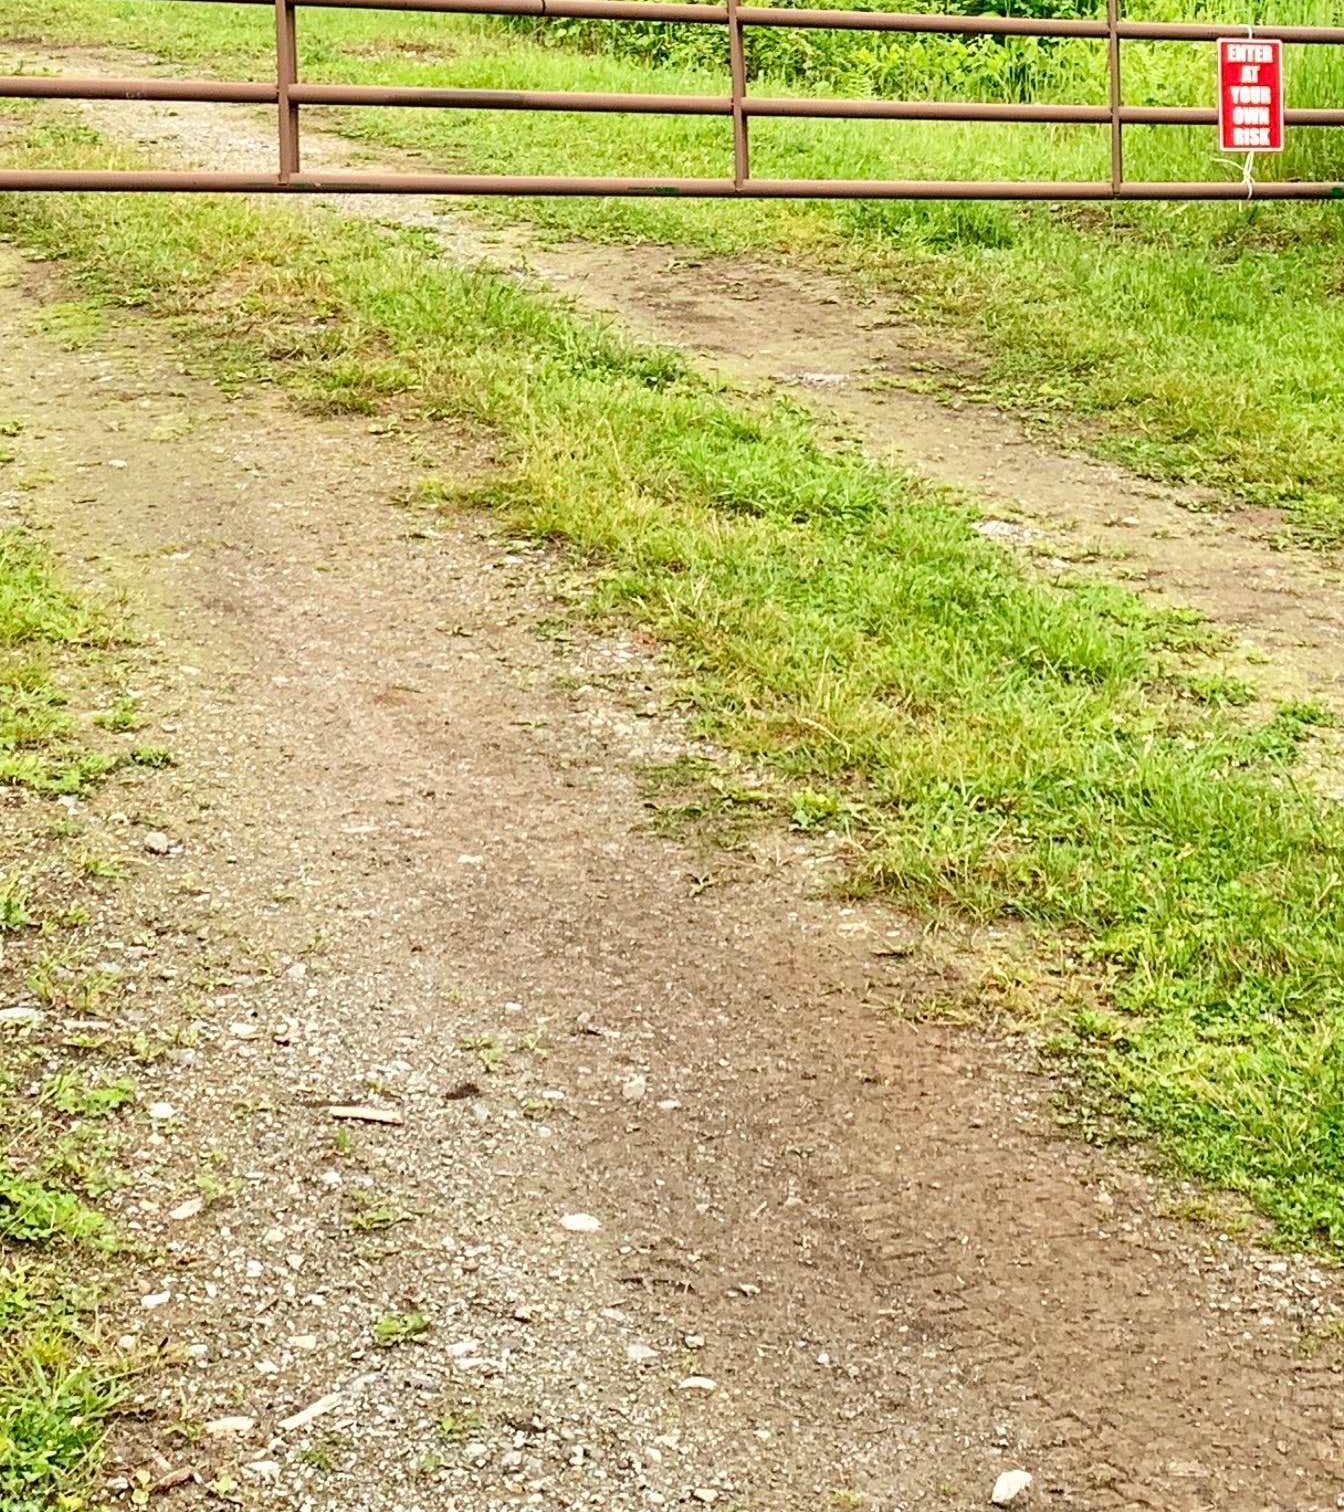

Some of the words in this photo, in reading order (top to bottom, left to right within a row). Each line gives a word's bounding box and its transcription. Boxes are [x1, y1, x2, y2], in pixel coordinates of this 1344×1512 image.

[1227, 44, 1273, 63] ENTER
[1241, 65, 1260, 83] AT
[1229, 85, 1272, 104] YOUR
[1232, 106, 1270, 125] OWN
[1233, 127, 1271, 146] RISK
